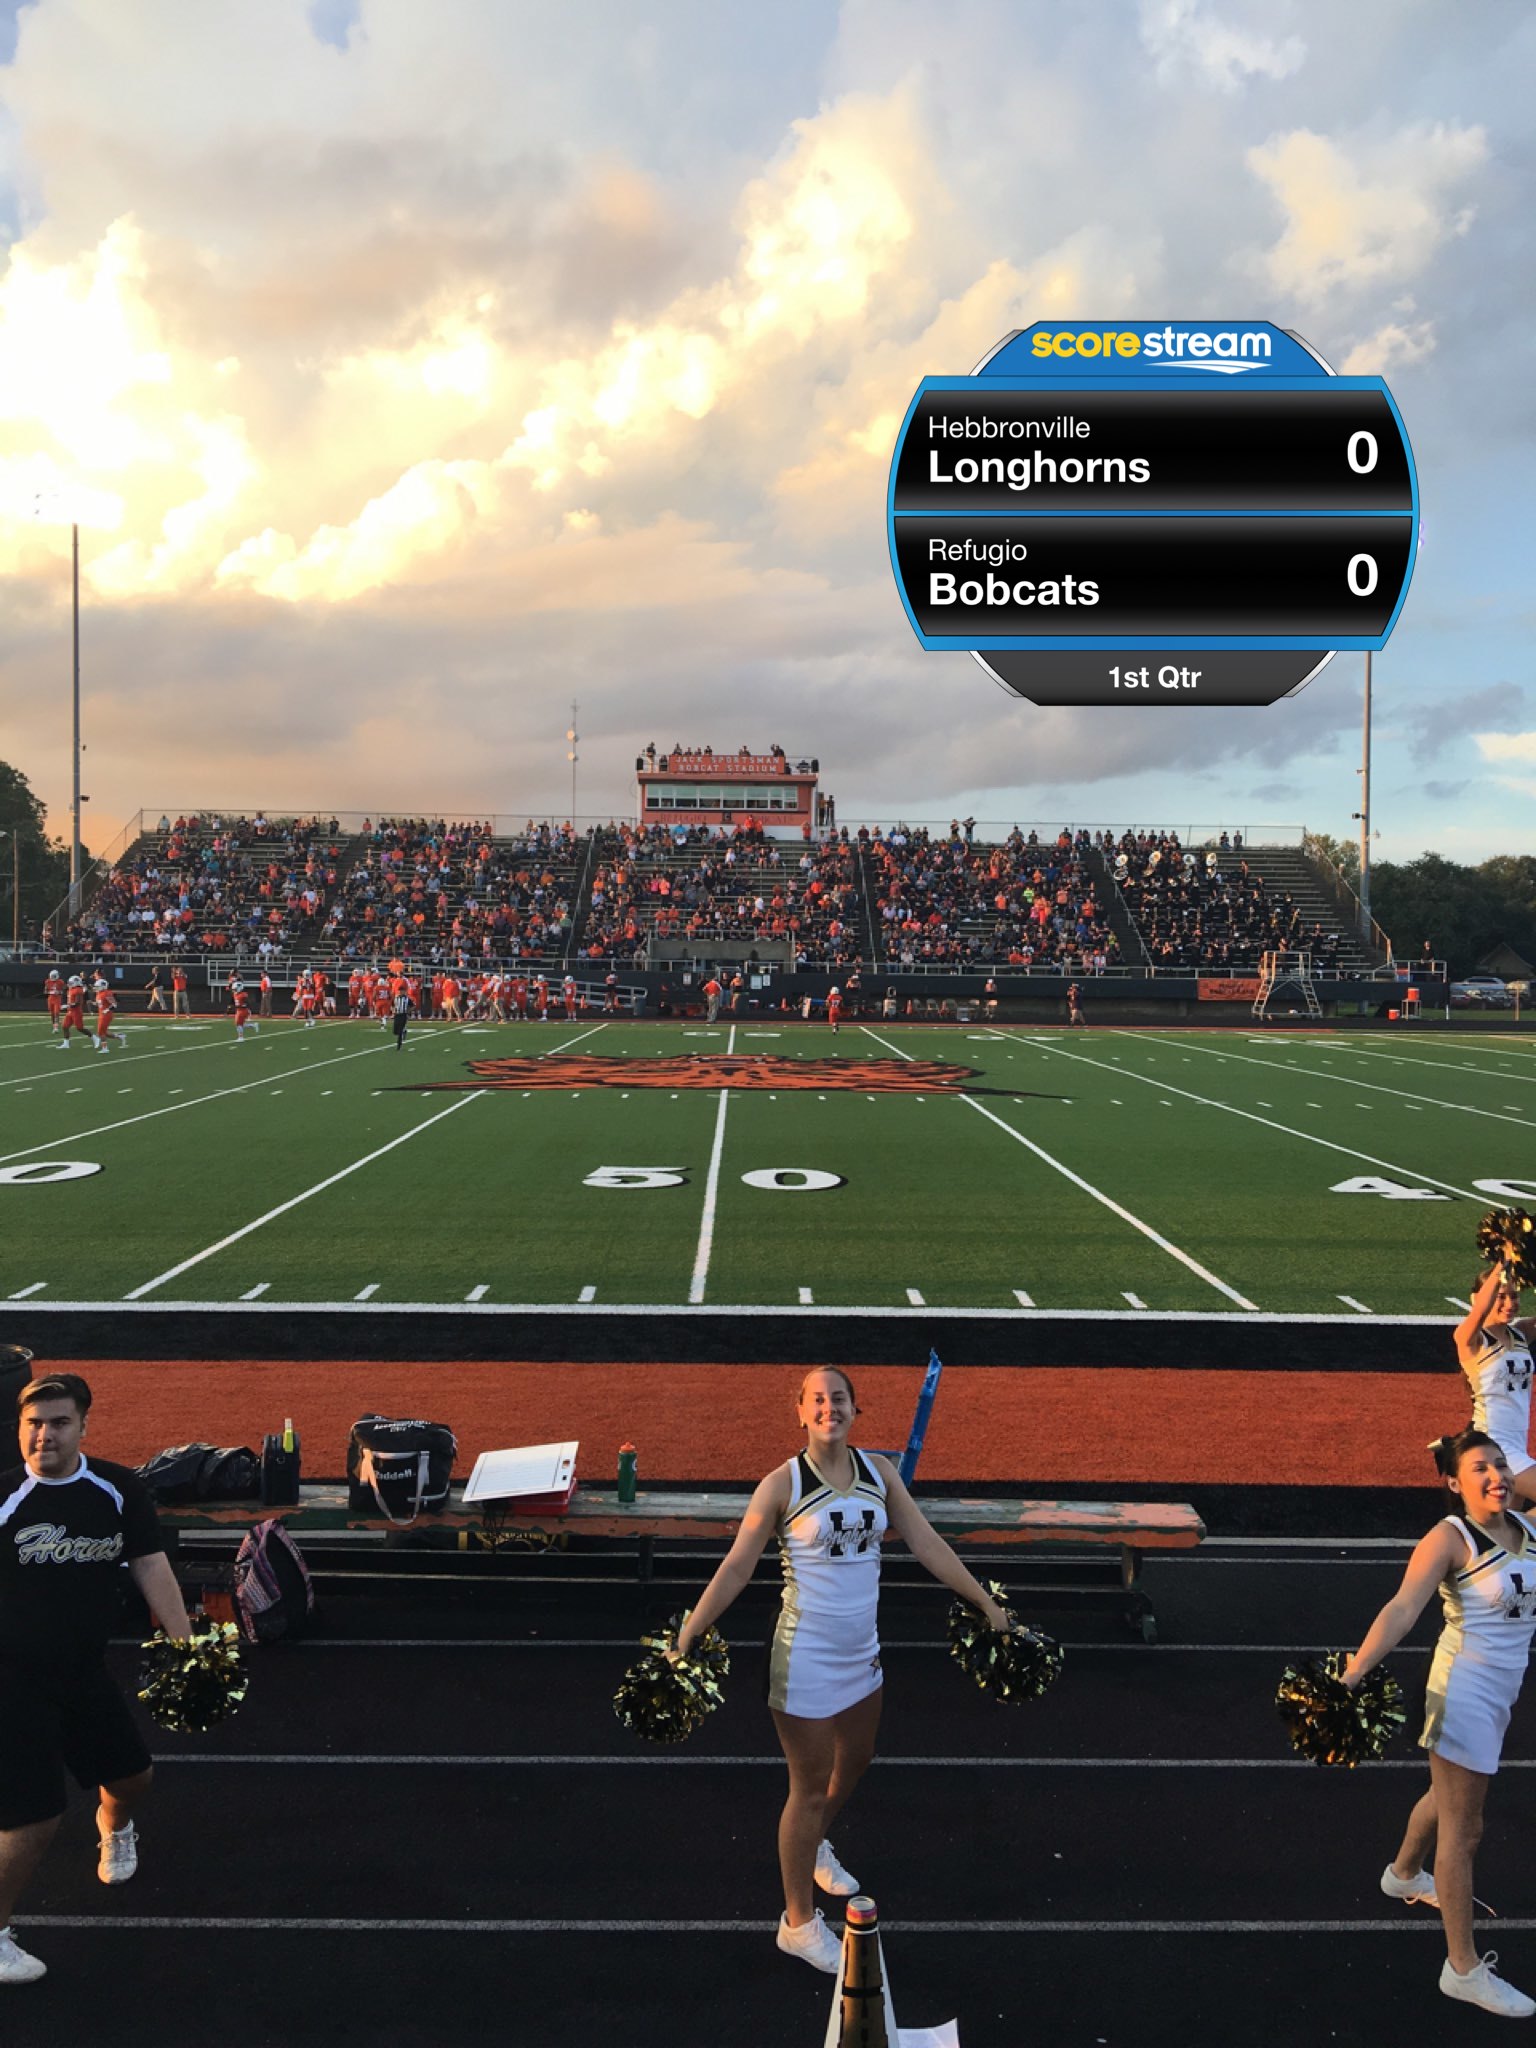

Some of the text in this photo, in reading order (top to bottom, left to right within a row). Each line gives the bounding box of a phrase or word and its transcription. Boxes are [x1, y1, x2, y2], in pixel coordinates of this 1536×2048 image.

[711, 756, 780, 764] SPORTSMAN
[678, 764, 777, 772] BOBCAT STADIUM
[13, 1522, 124, 1566] Horns
